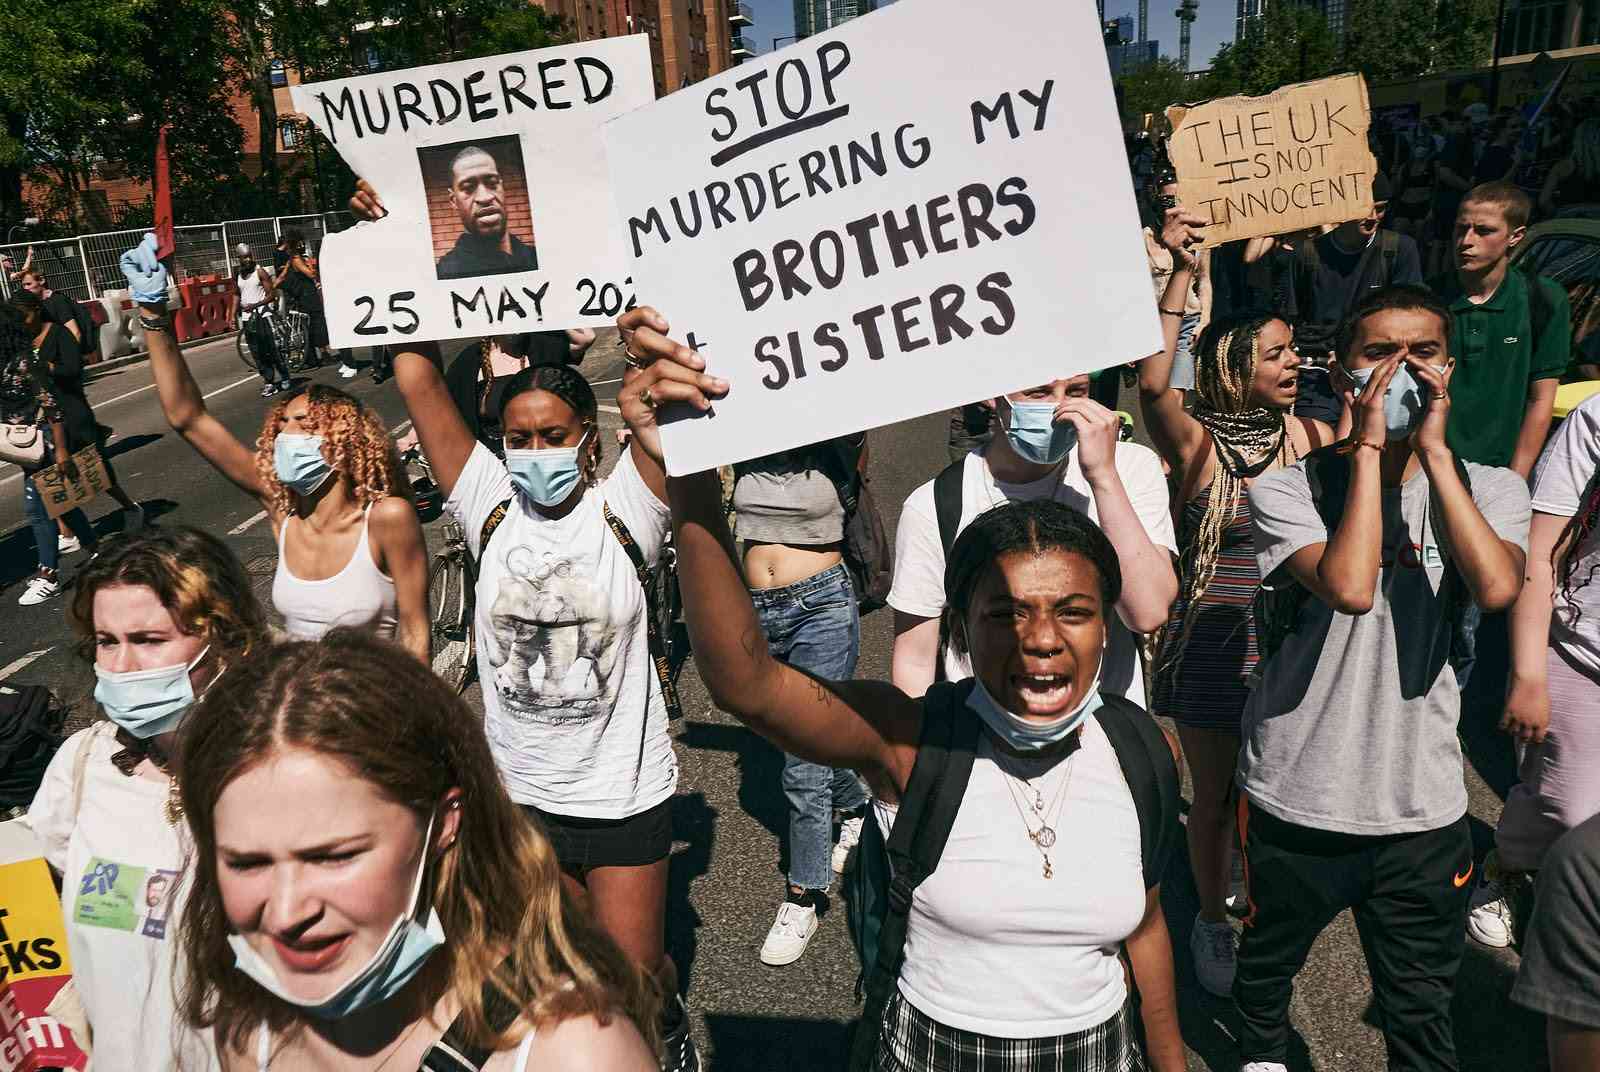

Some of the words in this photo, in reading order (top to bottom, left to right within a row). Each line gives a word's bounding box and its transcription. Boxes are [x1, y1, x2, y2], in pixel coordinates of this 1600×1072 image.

[313, 56, 615, 144] MURDERED
[705, 40, 850, 142] STOP
[1184, 111, 1274, 162] THE
[1288, 99, 1356, 143] UK
[628, 123, 931, 257] MURDERING
[970, 79, 1054, 144] MY
[1199, 172, 1366, 227] INNOCENT
[1214, 152, 1271, 185] IS
[1276, 143, 1334, 175] NOT
[732, 176, 1037, 312] BROTHERS
[353, 290, 420, 335] 25
[450, 281, 550, 329] MAY
[753, 271, 1016, 390] SISTERS
